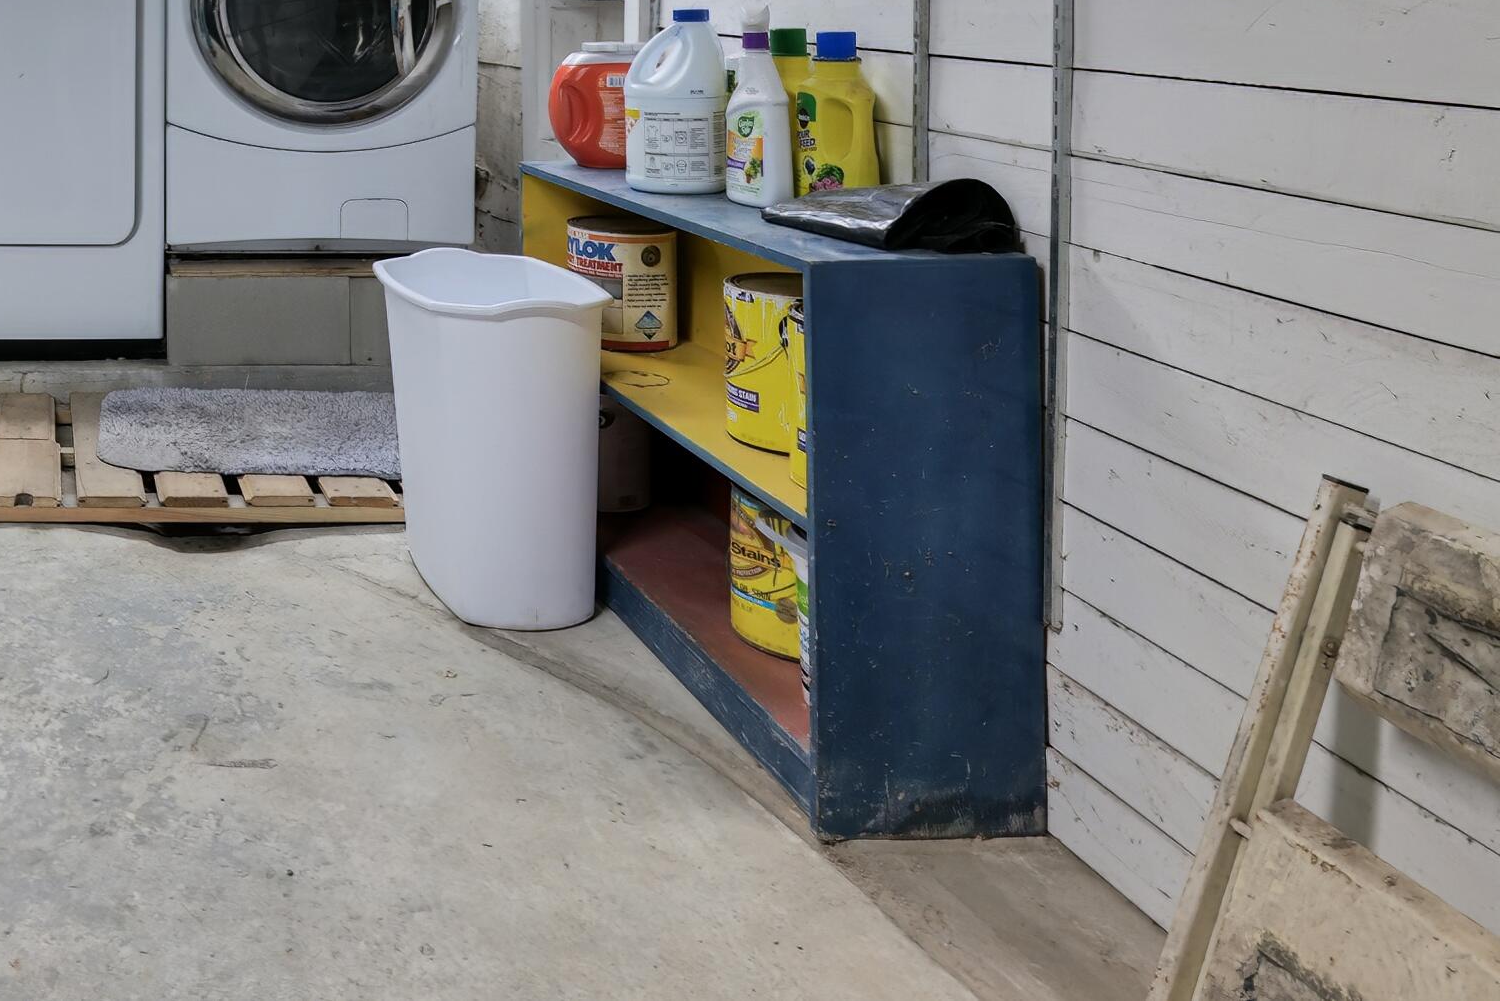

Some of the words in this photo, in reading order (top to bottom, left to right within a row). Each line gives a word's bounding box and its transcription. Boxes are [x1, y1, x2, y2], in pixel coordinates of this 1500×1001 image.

[568, 236, 616, 261] YLOK
[576, 256, 623, 272] TREATMENT
[731, 541, 782, 569] Stains
